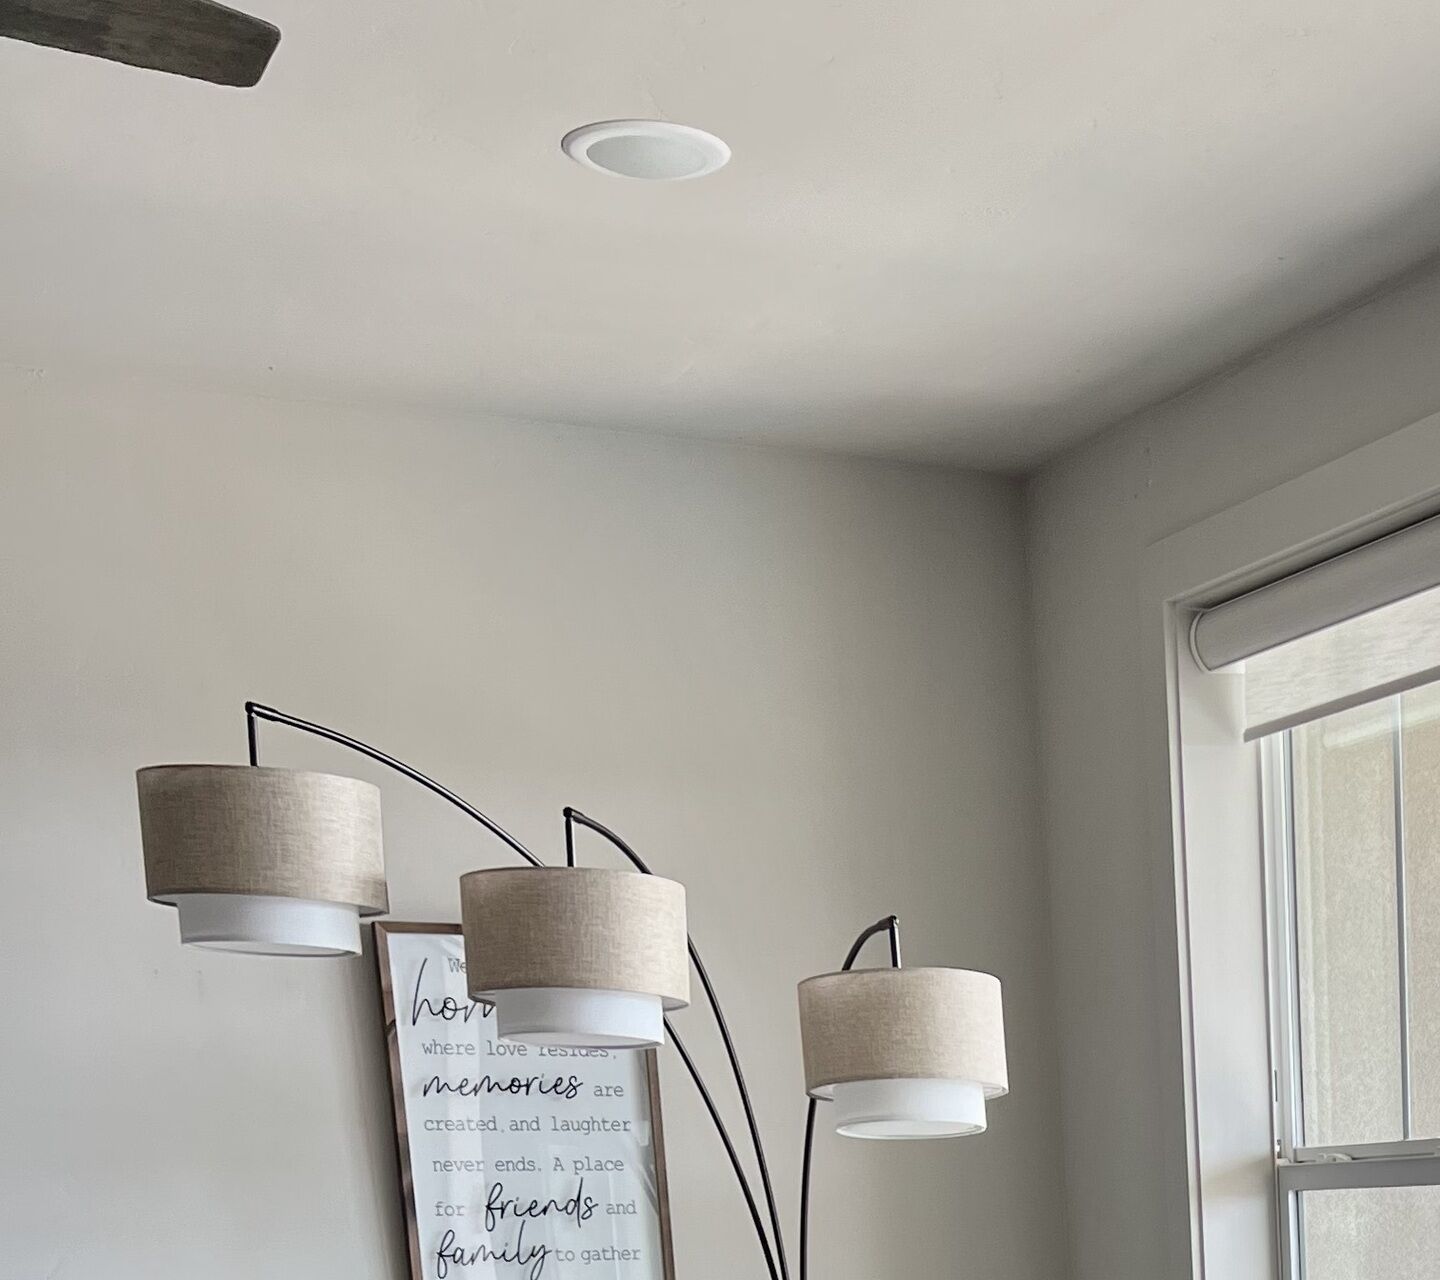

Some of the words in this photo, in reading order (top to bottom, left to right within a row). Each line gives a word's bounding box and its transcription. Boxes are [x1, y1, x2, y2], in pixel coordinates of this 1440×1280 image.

[422, 1039, 476, 1057] where
[486, 1040, 528, 1056] love
[423, 1073, 584, 1100] memories
[593, 1084, 625, 1098] are
[509, 1115, 542, 1132] and
[551, 1116, 632, 1135] laughter
[432, 1158, 485, 1172] never
[494, 1156, 542, 1172] ends.
[553, 1156, 565, 1172] A
[572, 1156, 625, 1176] place
[434, 1201, 465, 1217] for
[485, 1177, 599, 1233] friends
[606, 1200, 638, 1216] and
[554, 1246, 576, 1263] to
[580, 1246, 641, 1265] gather
